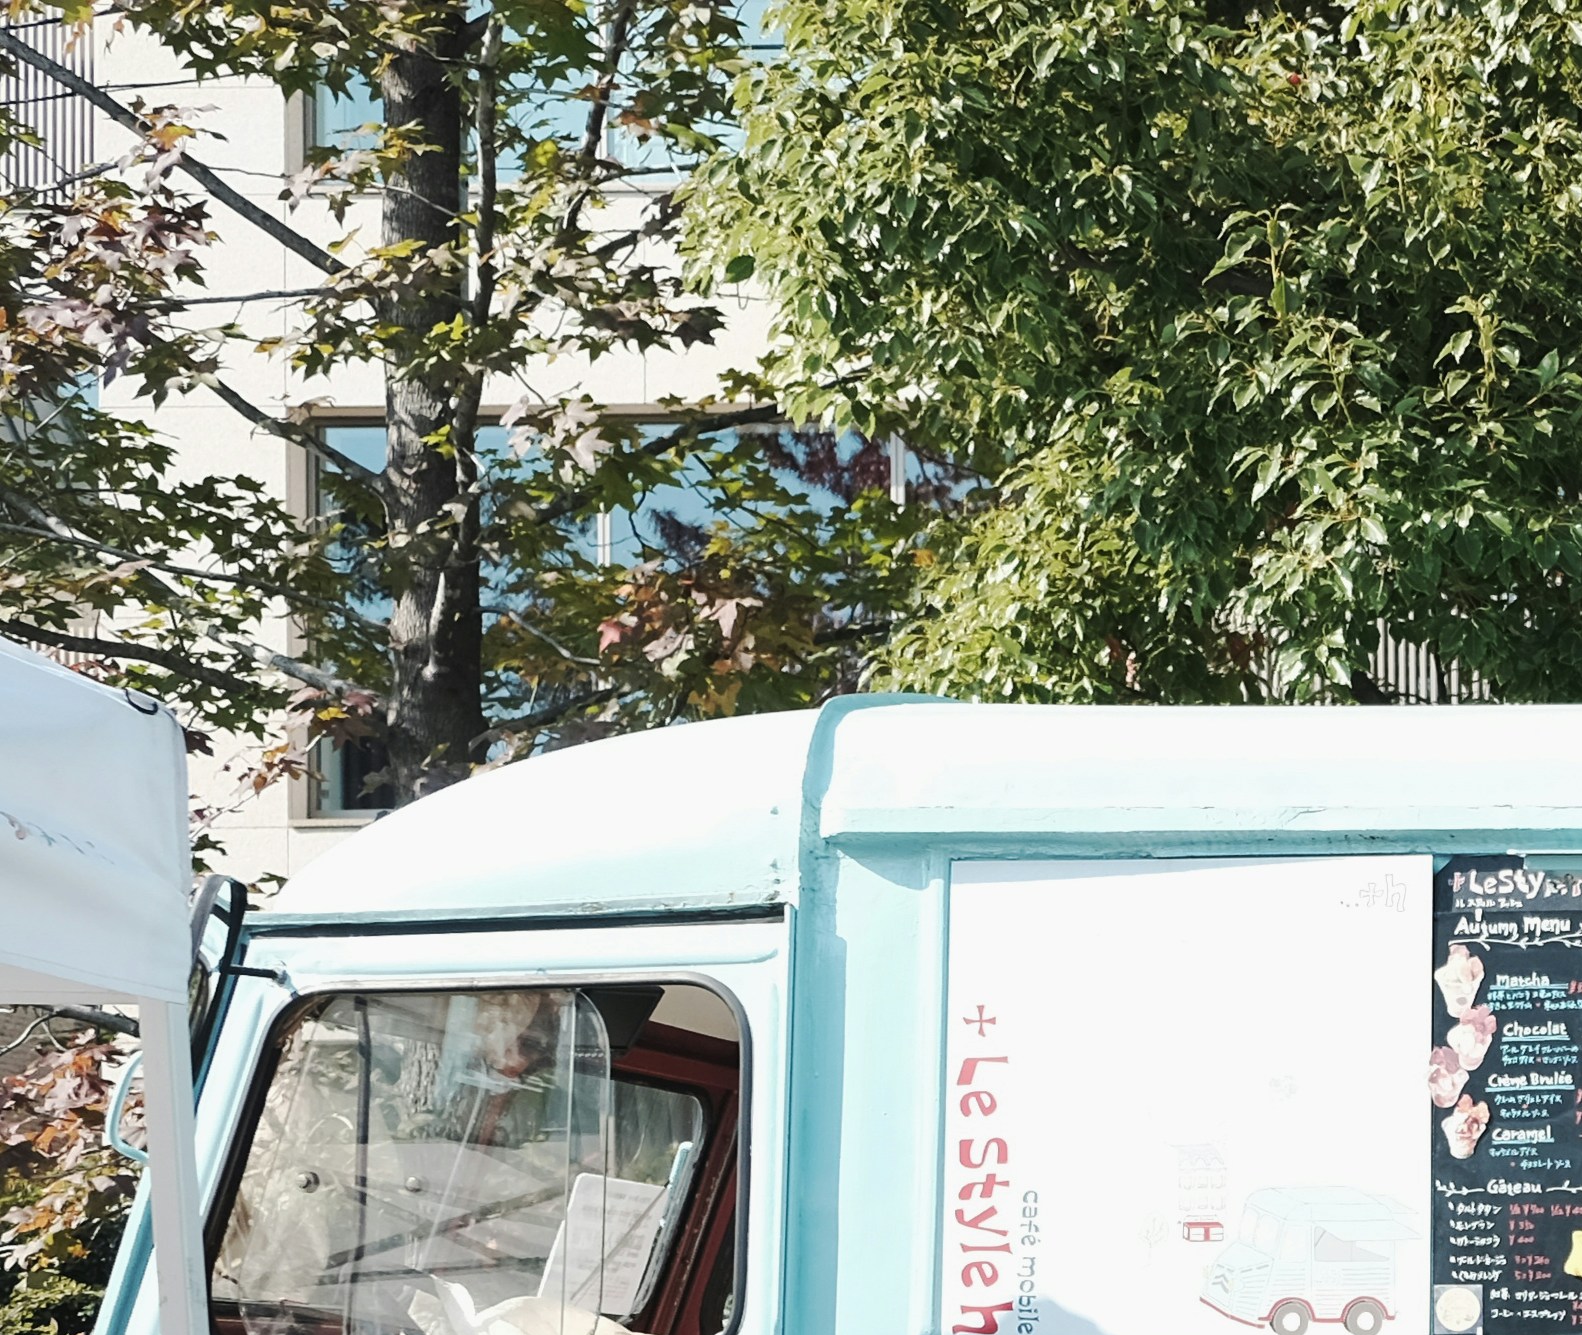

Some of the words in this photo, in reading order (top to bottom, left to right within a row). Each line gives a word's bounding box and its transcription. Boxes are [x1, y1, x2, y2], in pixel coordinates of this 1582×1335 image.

[1454, 916, 1519, 937] Autumn
[1523, 915, 1571, 937] Menu
[1496, 971, 1550, 987] Matcha
[1503, 1020, 1568, 1037] Chocolat
[1492, 1124, 1552, 1144] Caramel
[1020, 1190, 1039, 1247] café
[1016, 1256, 1039, 1335] mobile
